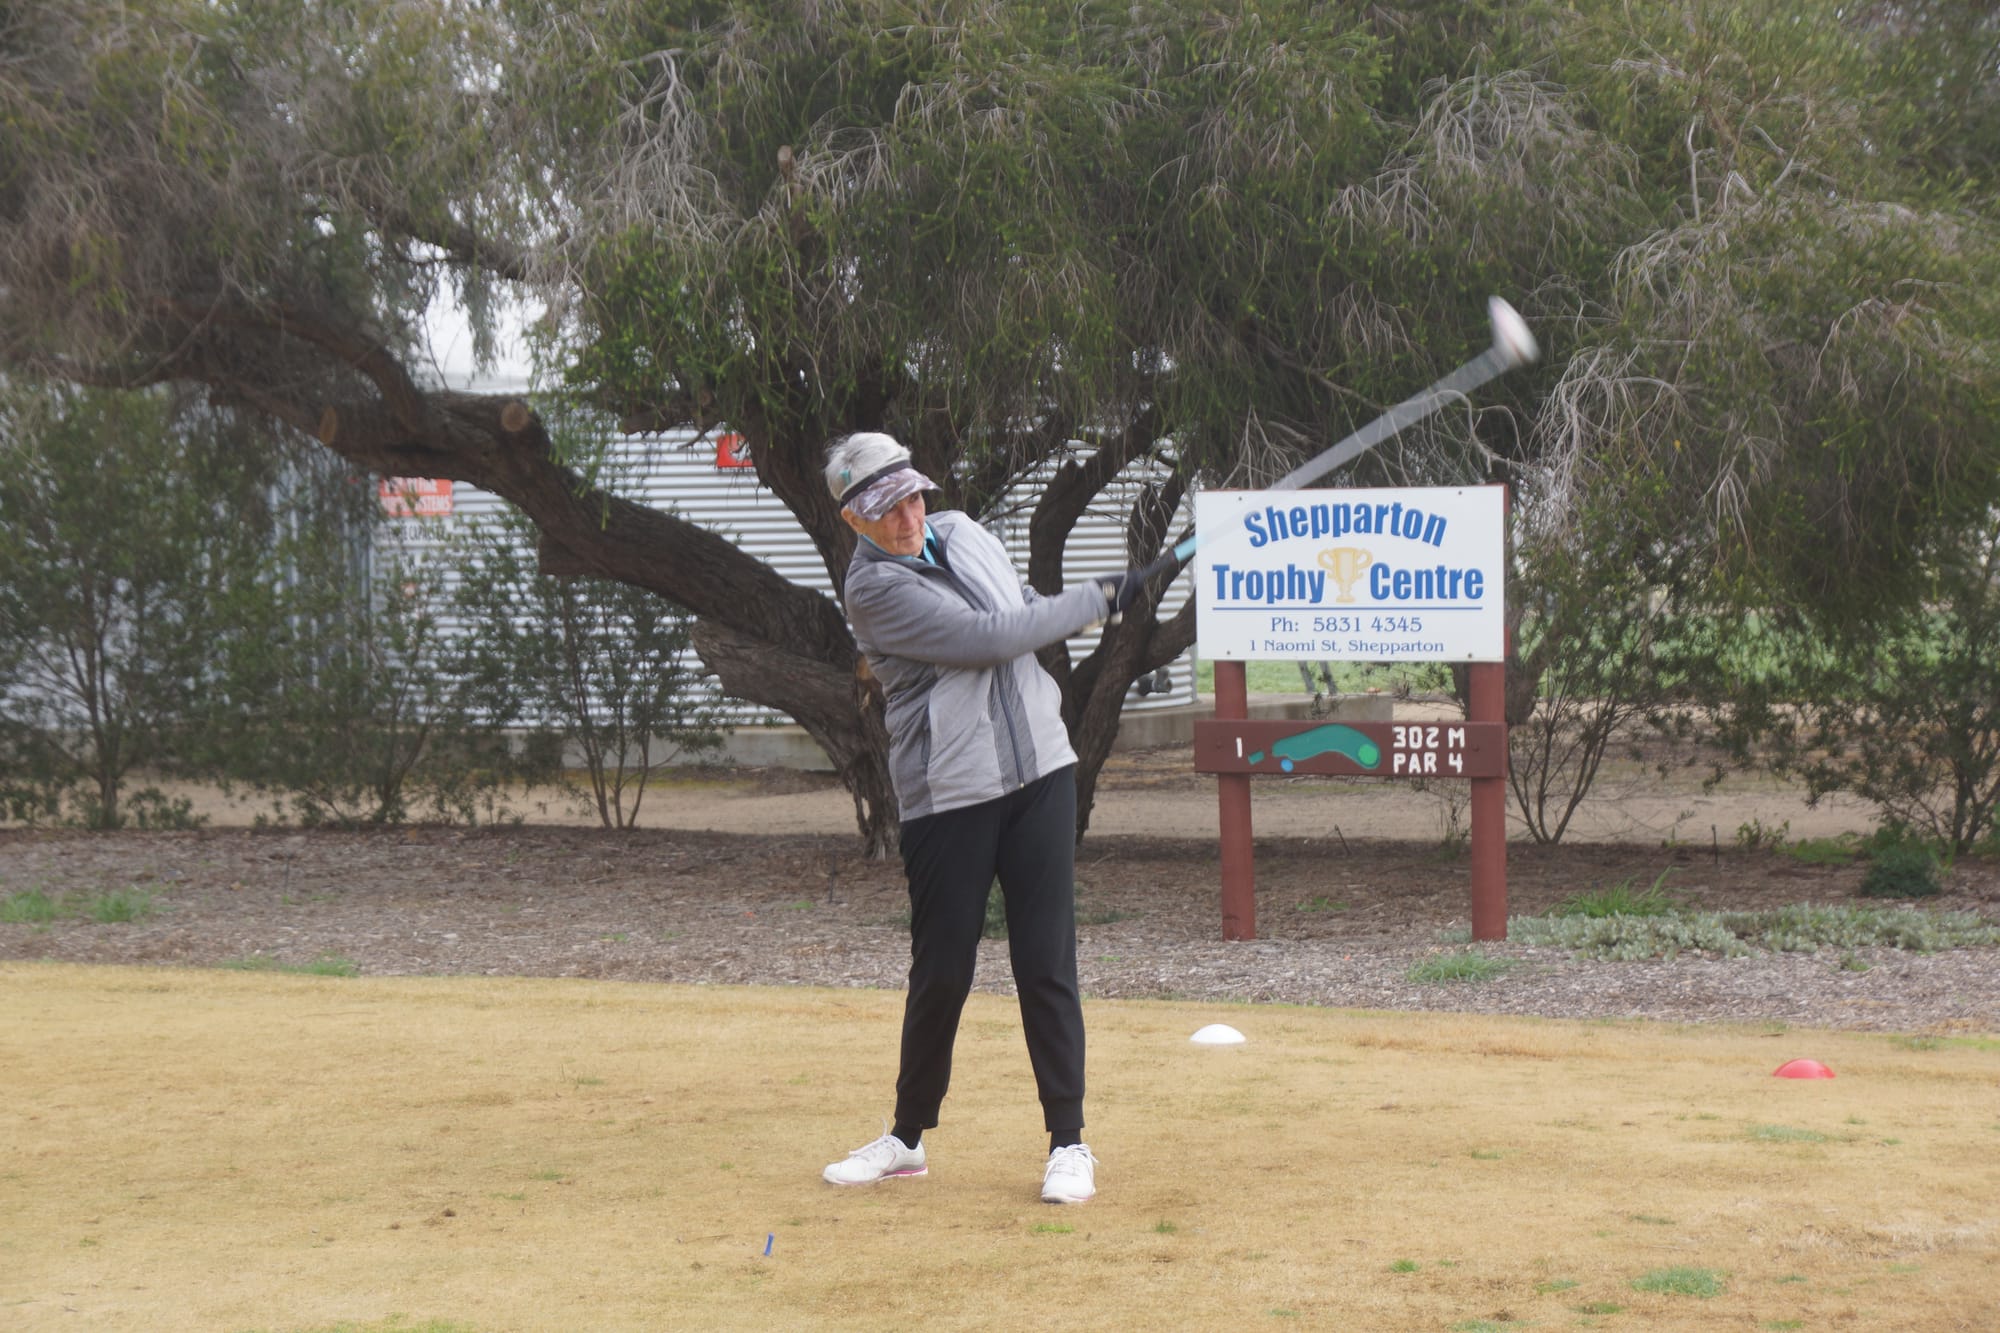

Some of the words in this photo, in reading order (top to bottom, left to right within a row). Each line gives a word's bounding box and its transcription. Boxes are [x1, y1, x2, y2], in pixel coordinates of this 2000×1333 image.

[1244, 501, 1447, 548] Shepparton
[1212, 563, 1325, 604] Trophy
[1370, 562, 1484, 600] Centre
[1271, 617, 1299, 632] Ph:
[1313, 616, 1361, 632] 5831
[1371, 616, 1422, 632] 4345
[1264, 640, 1315, 651] Naomi
[1321, 640, 1342, 653] St,
[1349, 639, 1444, 655] Shepparton
[1393, 726, 1439, 749] 302
[1448, 727, 1465, 748] M
[1393, 752, 1437, 774] PAR
[1449, 752, 1463, 774] 4
